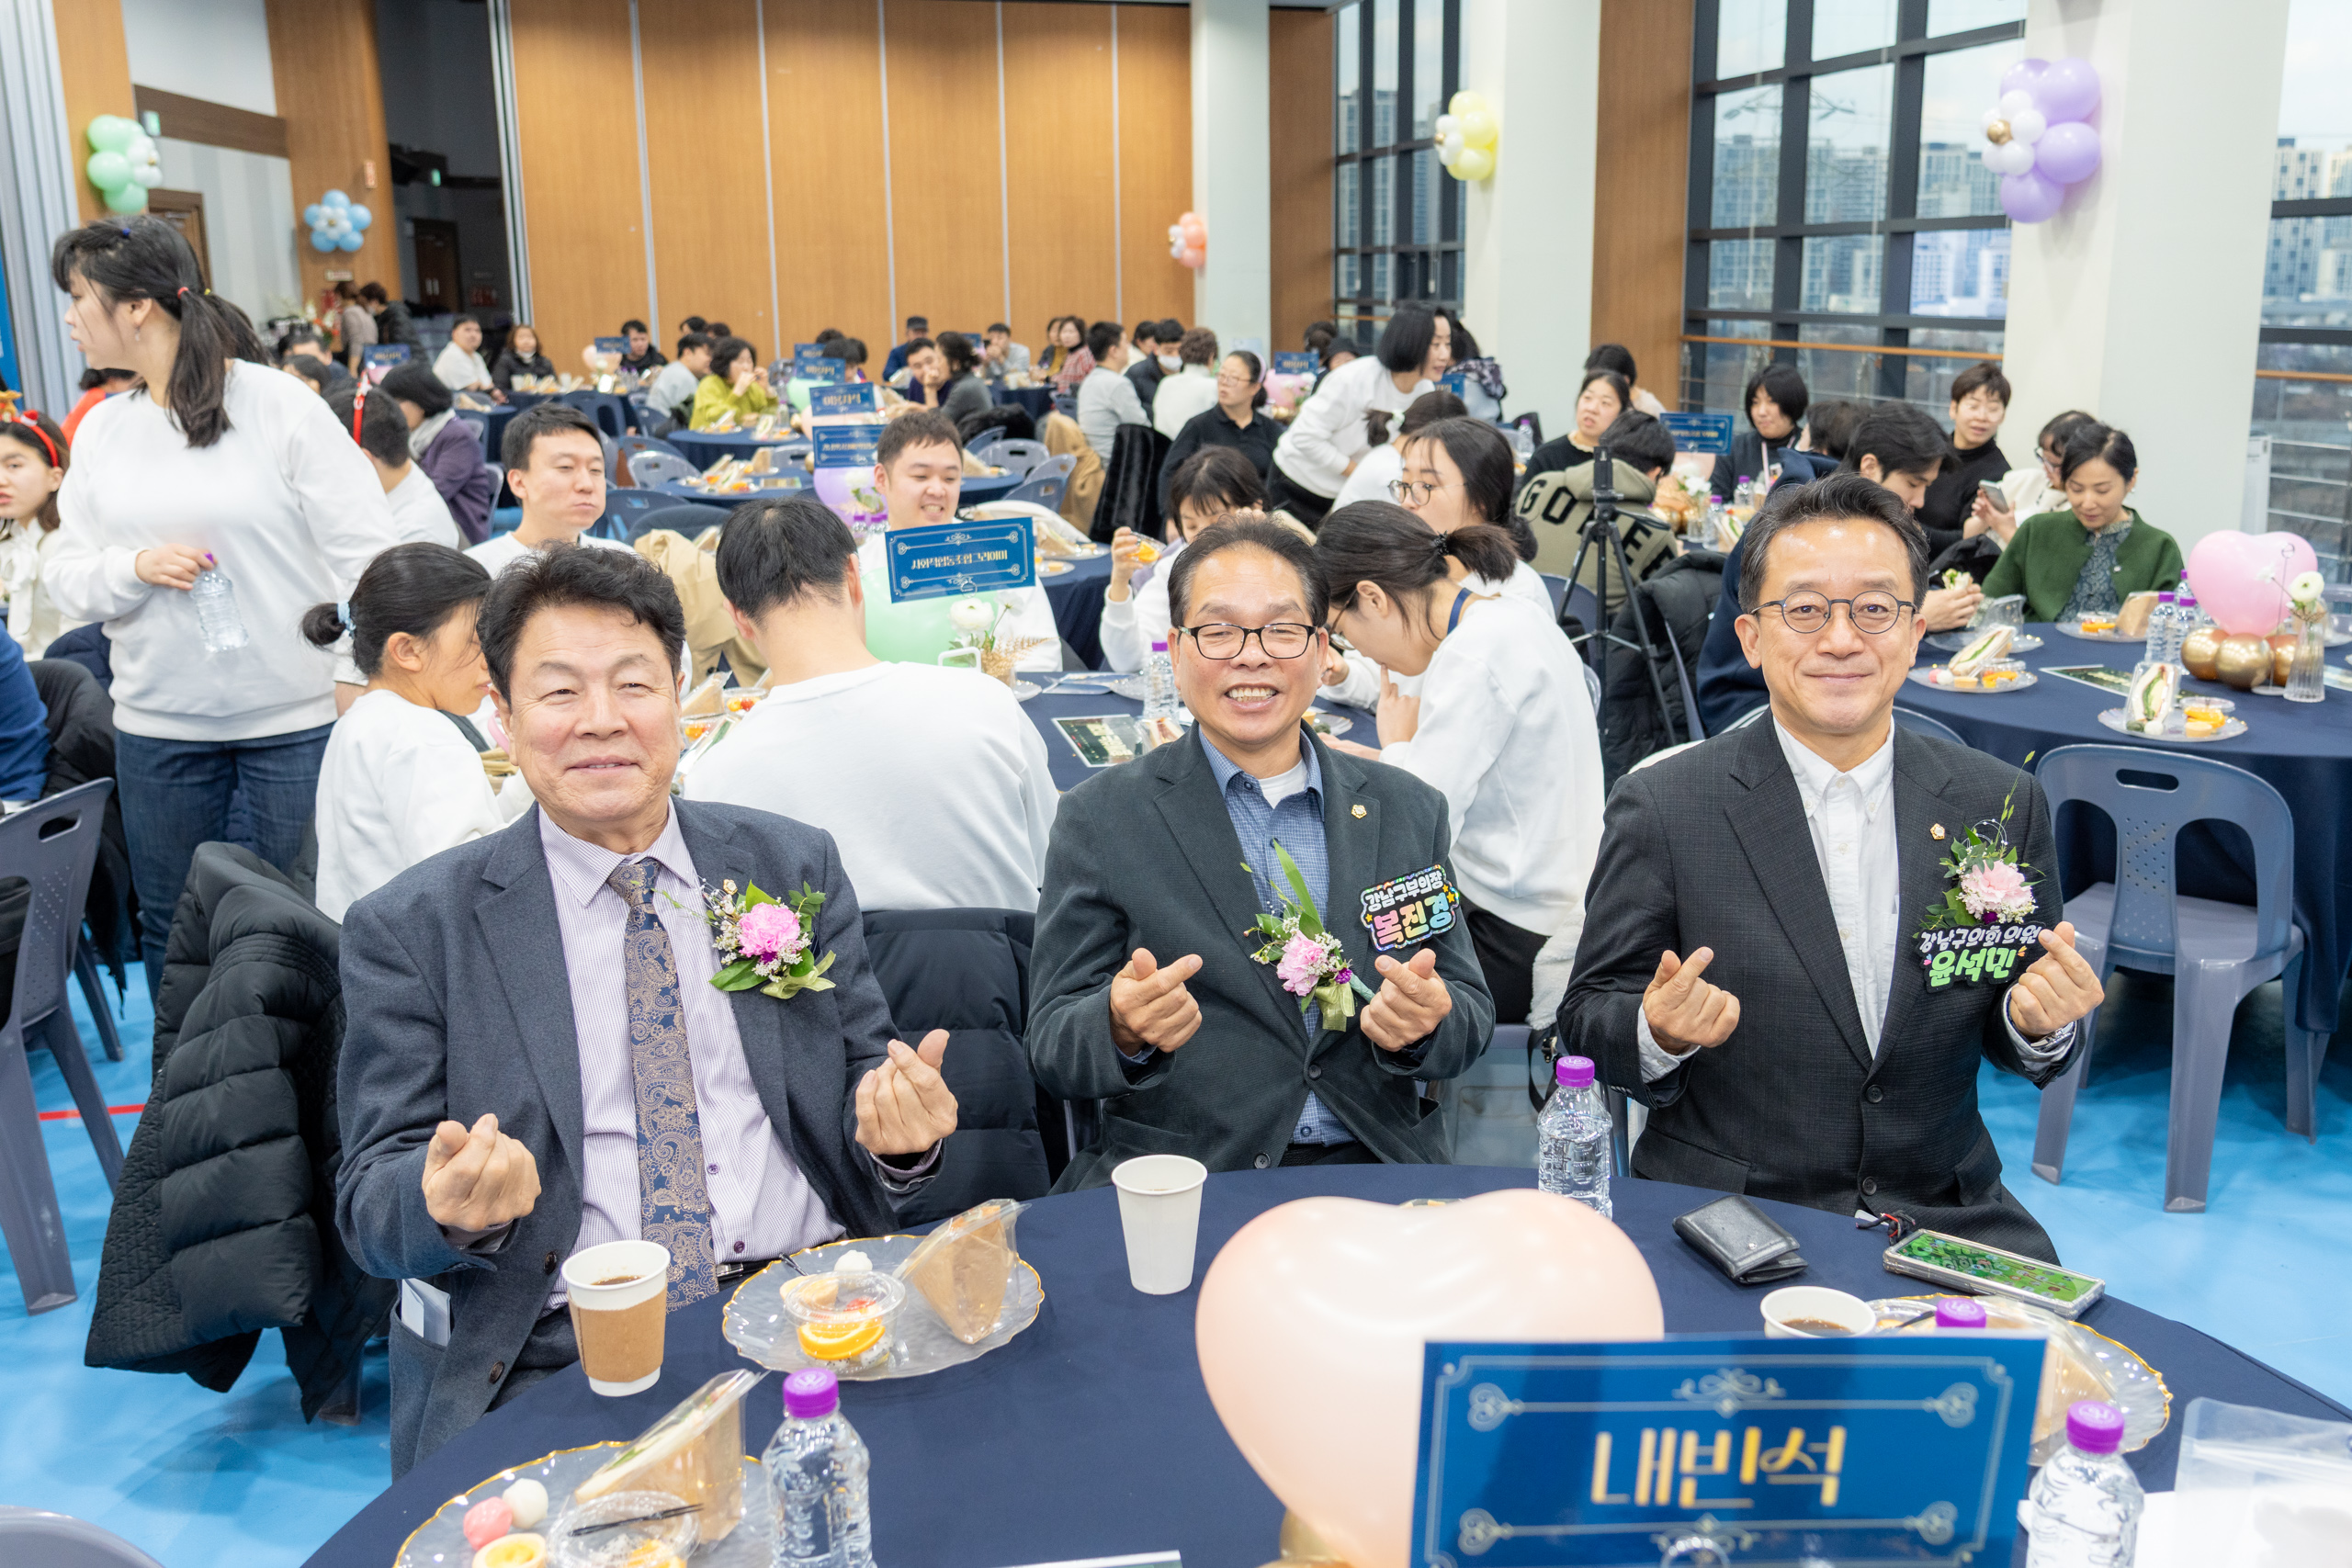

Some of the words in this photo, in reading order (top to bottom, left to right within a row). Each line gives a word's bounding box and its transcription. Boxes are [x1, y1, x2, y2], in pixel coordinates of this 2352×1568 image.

[1365, 871, 1443, 912] 강남구부의장
[1374, 892, 1452, 945] 복진경
[1919, 925, 2002, 953] 강남구의회
[2002, 924, 2042, 944] 의원
[1929, 947, 2017, 987] 윤석민
[1590, 1426, 1847, 1509] 내빈석
